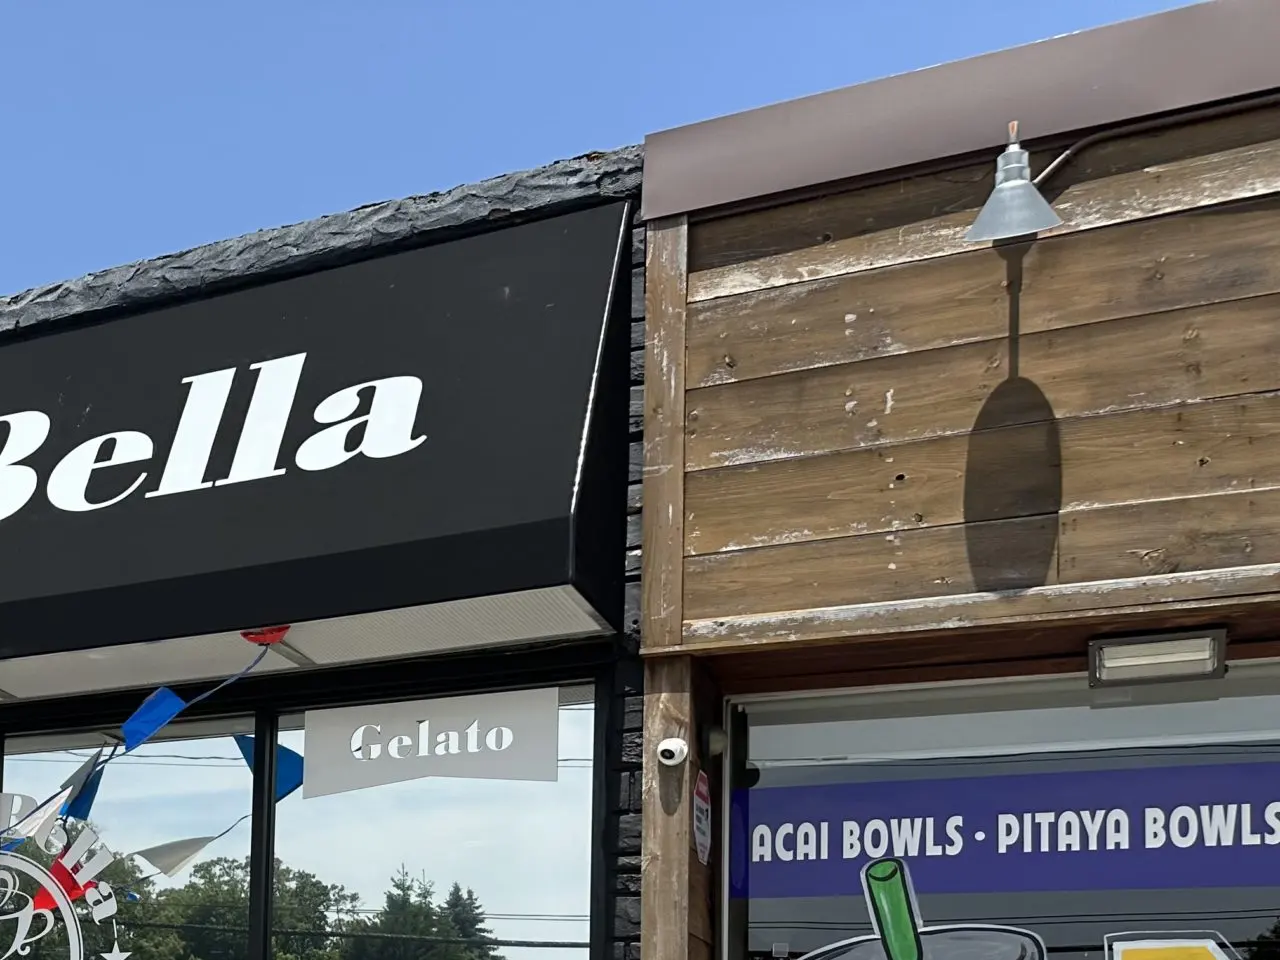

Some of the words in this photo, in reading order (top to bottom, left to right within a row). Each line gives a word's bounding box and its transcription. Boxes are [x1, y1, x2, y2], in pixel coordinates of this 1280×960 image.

[350, 709, 514, 762] Gelato
[752, 821, 829, 862] ACAI
[842, 815, 964, 858] BOWLS
[997, 808, 1130, 854] PITAYA
[1144, 801, 1280, 849] BOWLS
